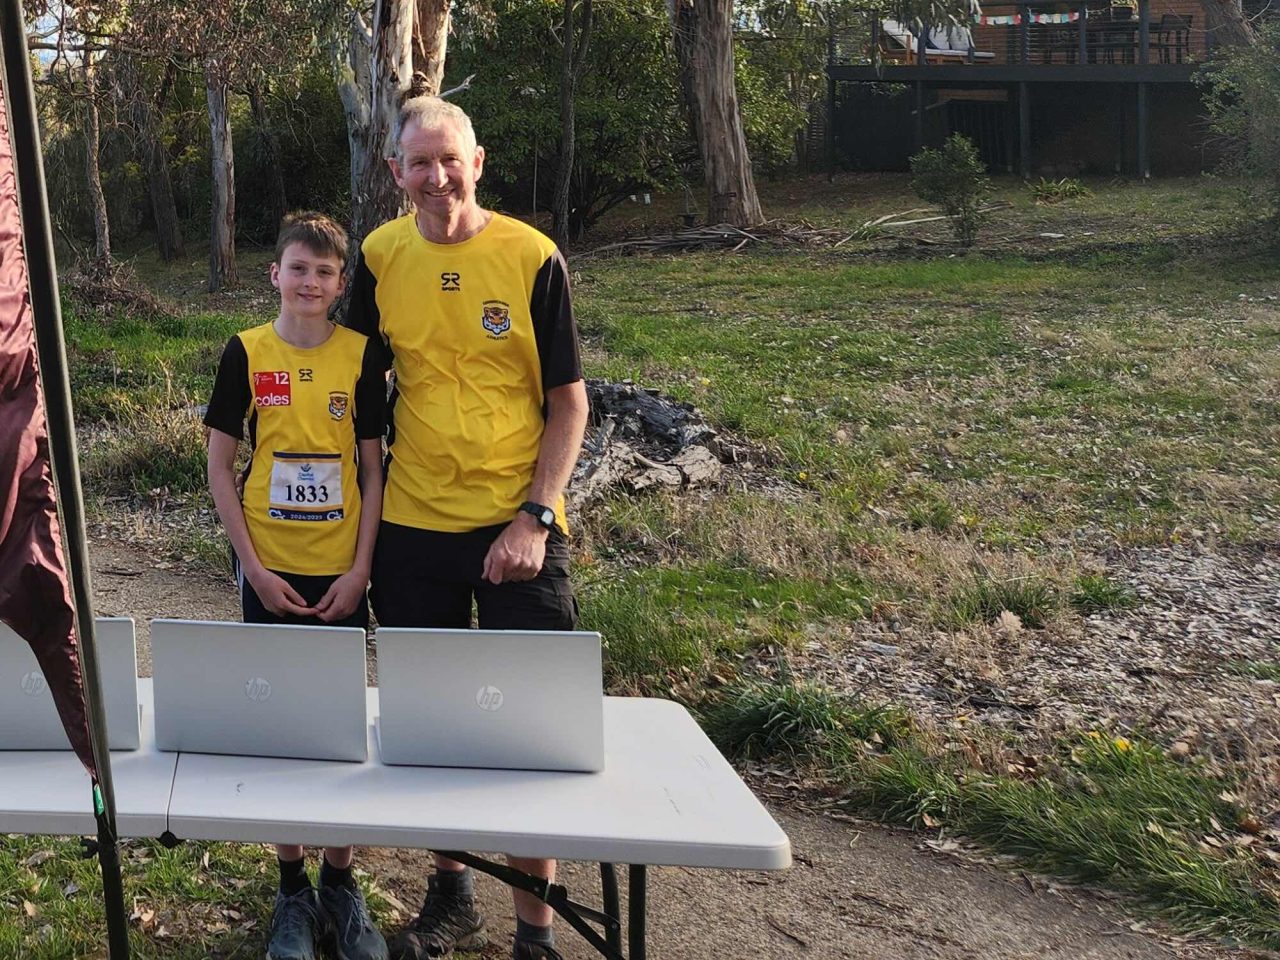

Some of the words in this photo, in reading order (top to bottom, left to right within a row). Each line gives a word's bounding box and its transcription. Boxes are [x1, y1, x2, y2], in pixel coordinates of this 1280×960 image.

[273, 372, 289, 385] 12
[255, 392, 290, 406] coles
[286, 484, 329, 503] 1833
[479, 686, 501, 710] hp
